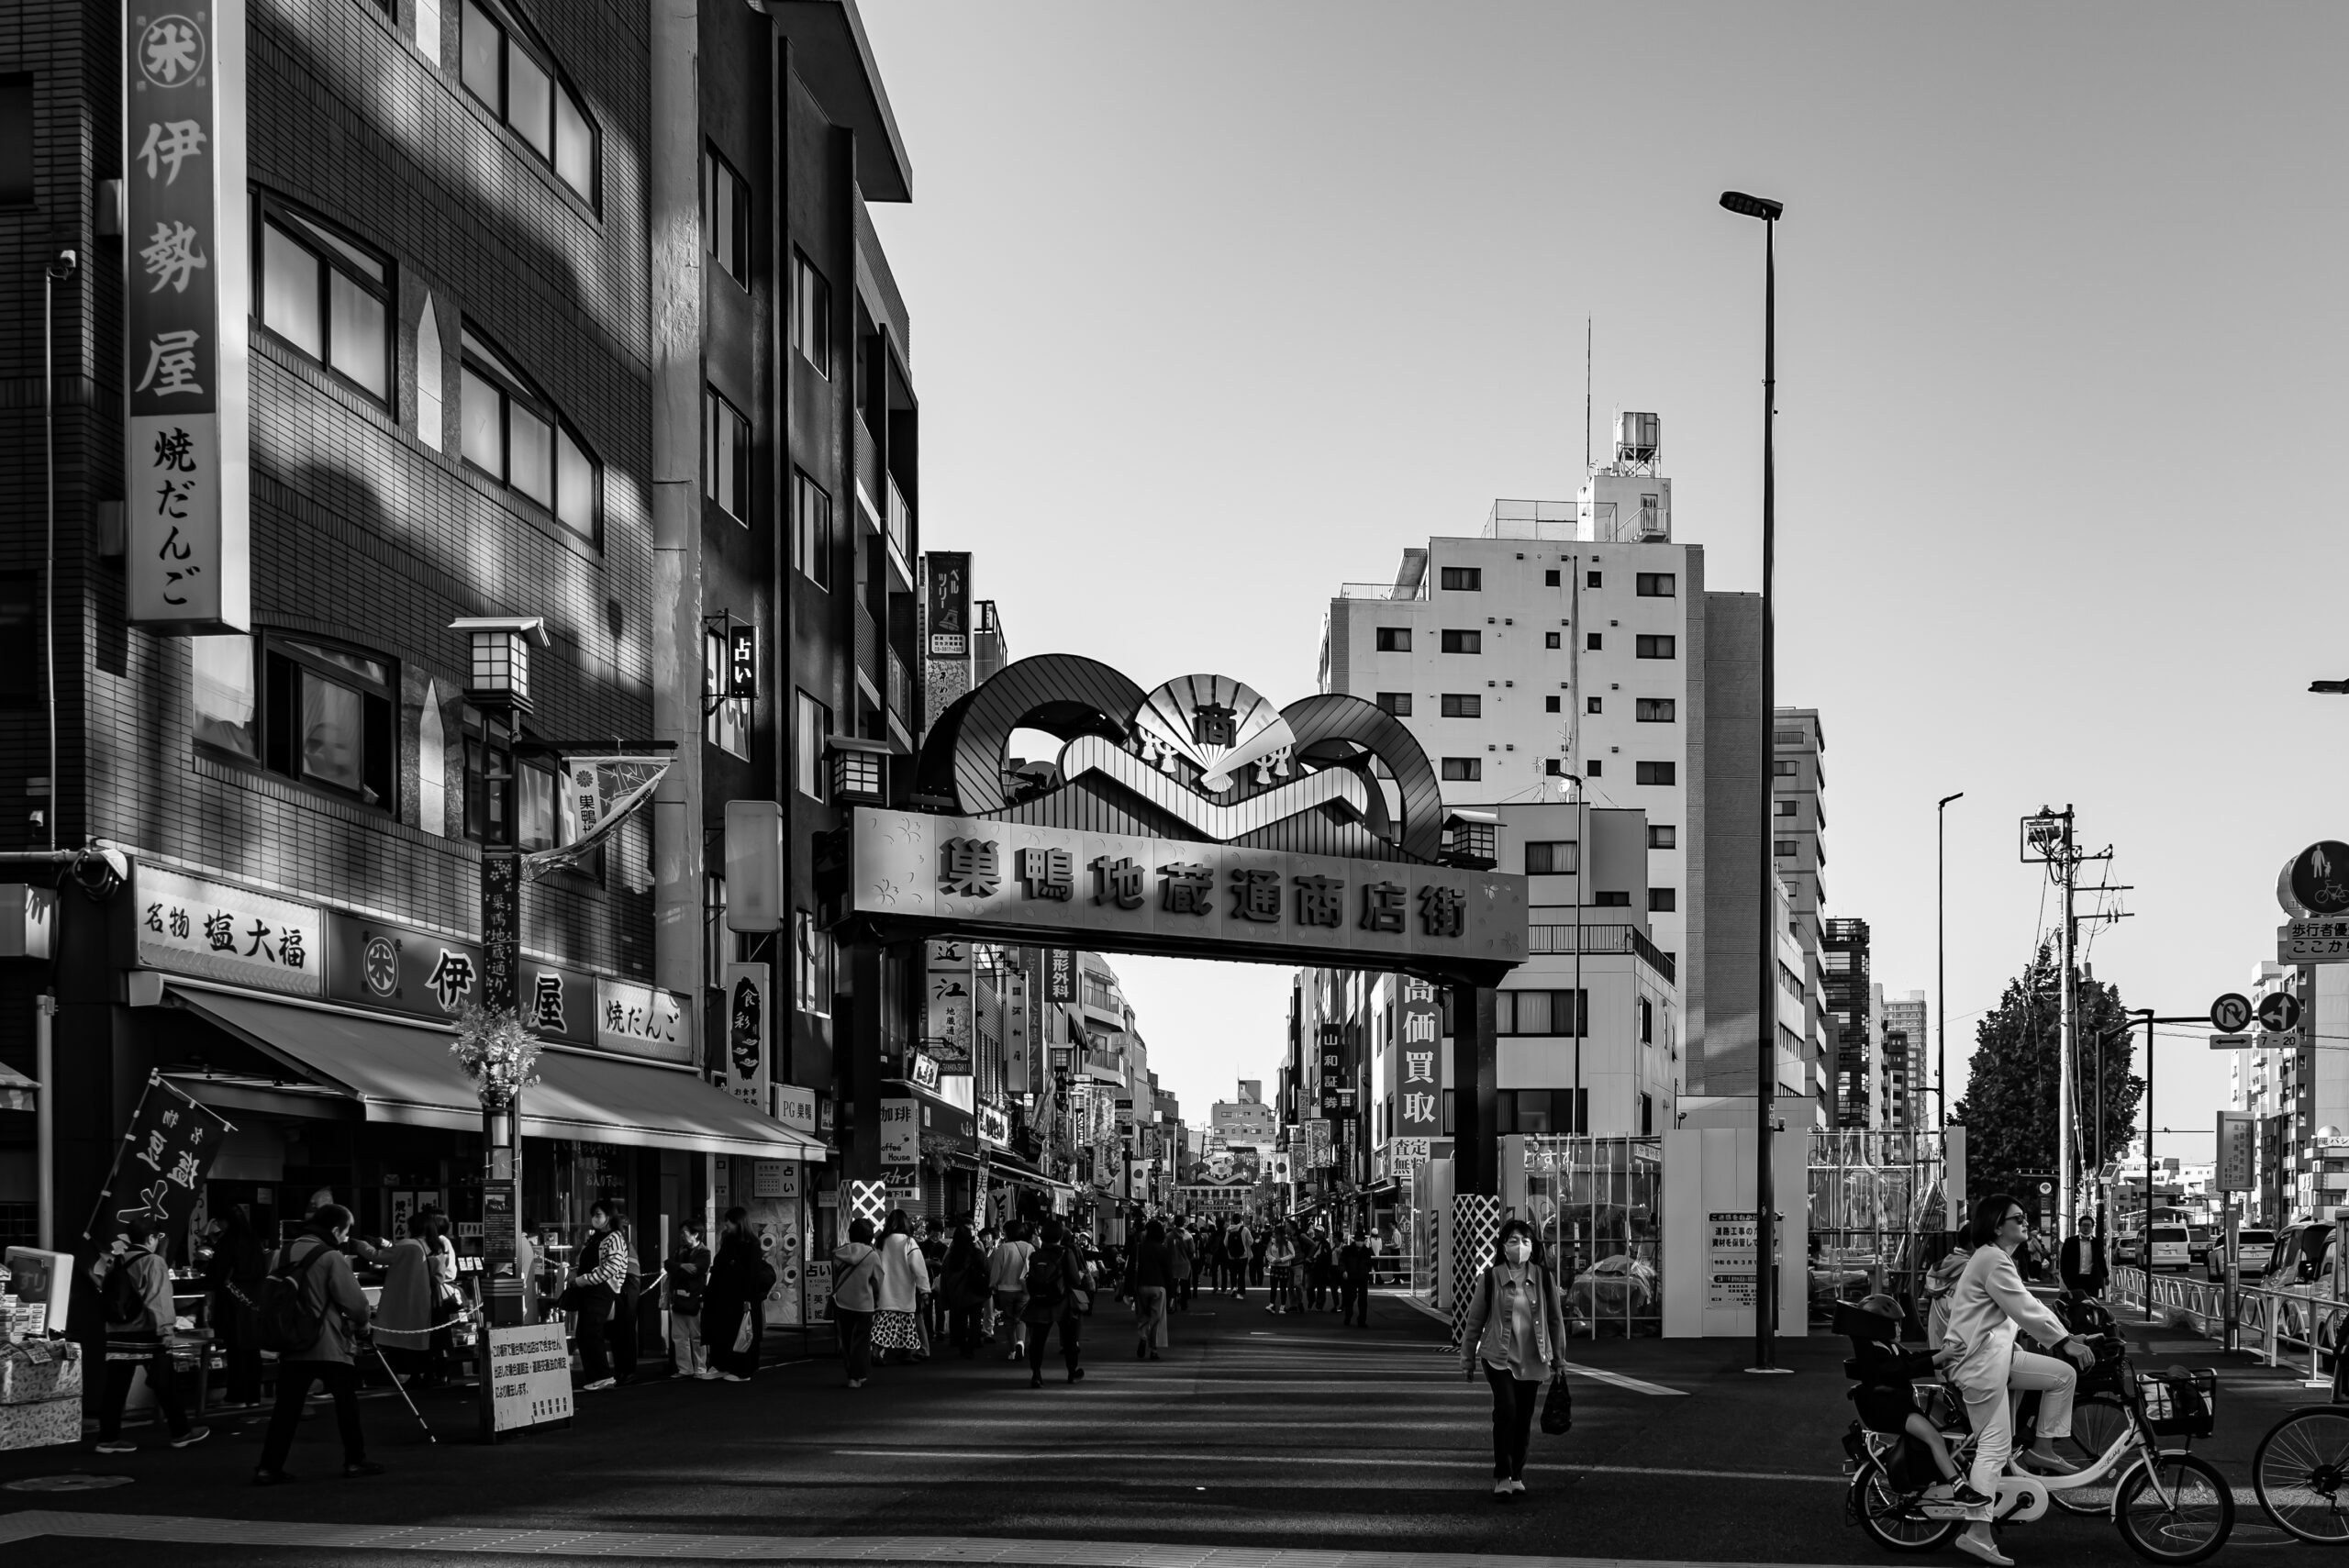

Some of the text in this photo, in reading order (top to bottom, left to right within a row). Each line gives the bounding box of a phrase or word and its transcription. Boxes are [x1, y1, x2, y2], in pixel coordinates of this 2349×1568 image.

[135, 118, 207, 397] 伊勢屋
[151, 426, 201, 606] 焼だんご
[734, 637, 752, 684] 占い
[1193, 703, 1237, 750] 商
[936, 836, 1466, 940] 巣鴨地蔵通商店街
[143, 902, 306, 970] 名物 塩大福
[490, 894, 507, 993] 巣鴨地蔵通り
[2292, 922, 2349, 937] 歩行者優
[2293, 940, 2349, 954] ここか
[425, 948, 568, 1034] 伊屋
[932, 940, 969, 1000] 近江
[1052, 949, 1069, 998] 整形外科
[606, 1000, 681, 1044] 焼だんご
[734, 988, 759, 1030] 食彩
[1323, 1033, 1339, 1109] 山和証券
[1402, 976, 1437, 1124] 高価買取
[784, 1101, 796, 1118] PG
[881, 1142, 902, 1151] offee
[888, 1153, 911, 1162] House
[1393, 1157, 1426, 1174] 無料
[1394, 1139, 1427, 1156] 査定
[784, 1166, 794, 1193] 占い
[881, 1166, 915, 1184] スカイ
[1712, 1238, 1779, 1247] 資材を保管してす
[807, 1264, 831, 1277] 占い
